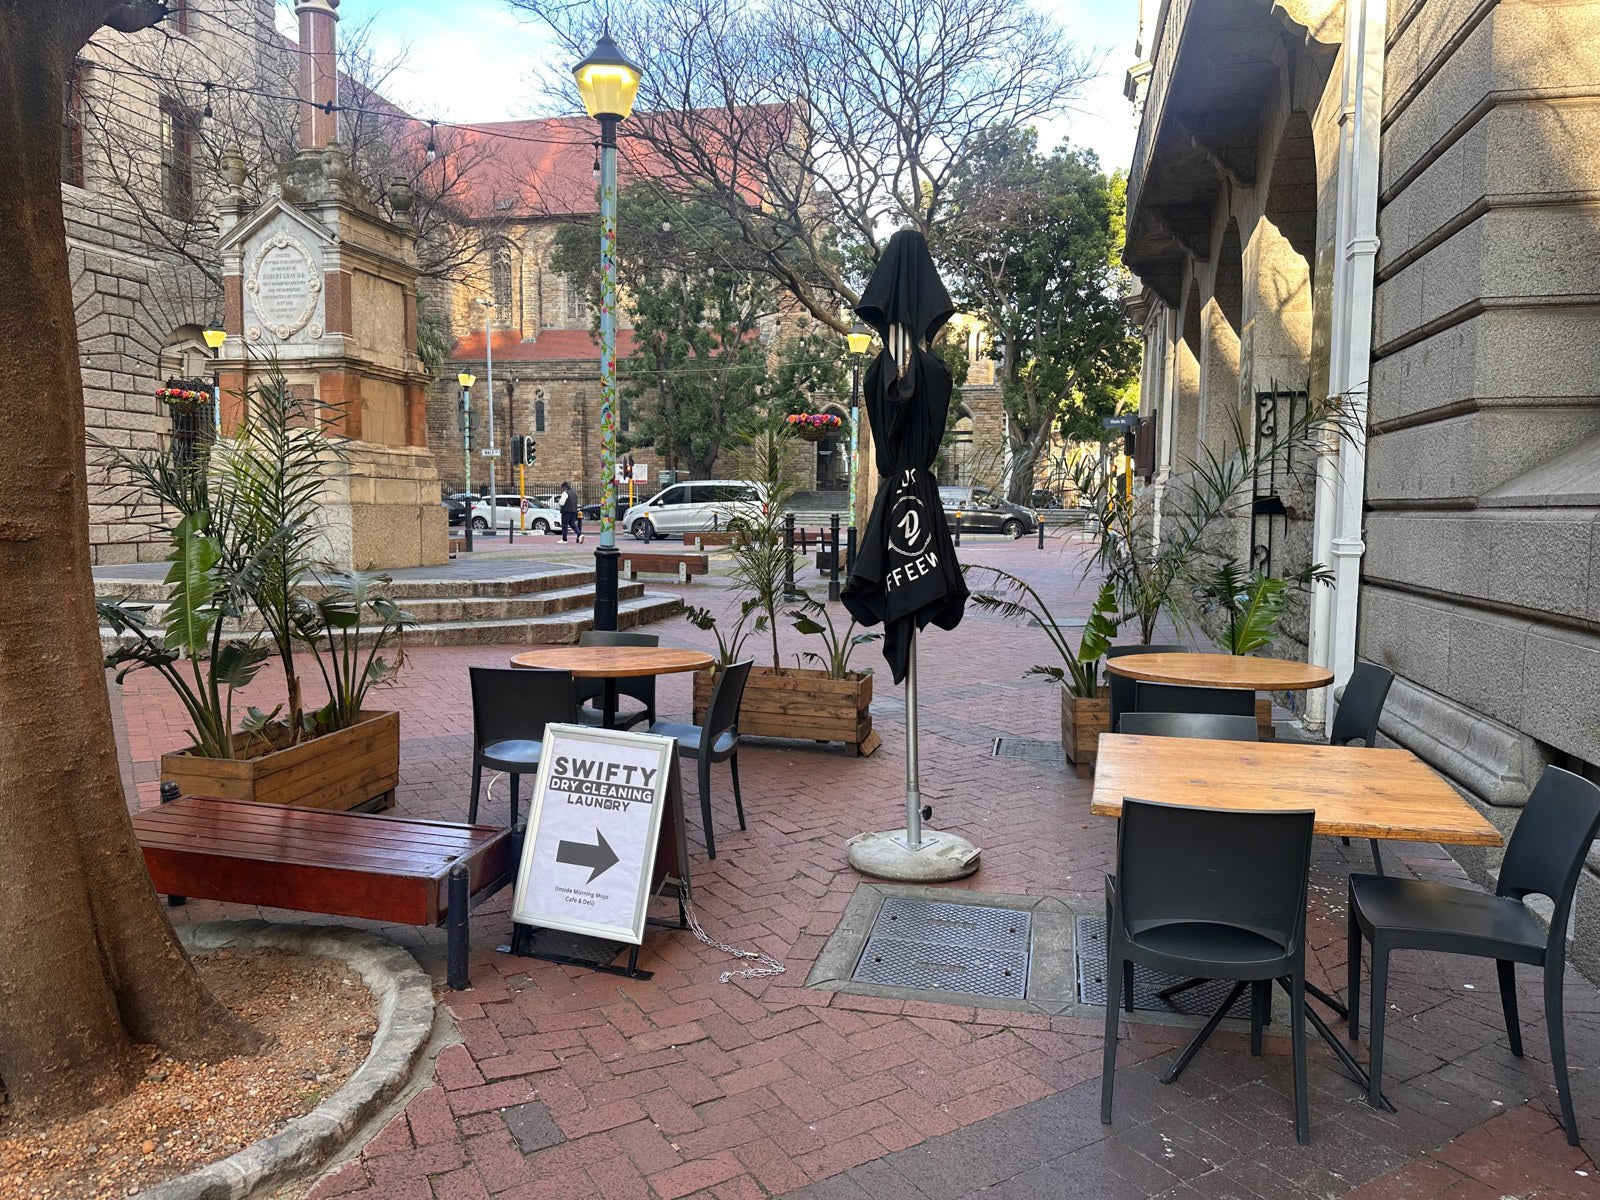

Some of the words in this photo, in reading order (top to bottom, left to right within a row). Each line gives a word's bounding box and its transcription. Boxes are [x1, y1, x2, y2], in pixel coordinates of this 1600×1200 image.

[554, 756, 657, 787] SWIFTY
[551, 778, 579, 792] DRY
[582, 782, 652, 801] CLEANING
[574, 888, 594, 899] Morning
